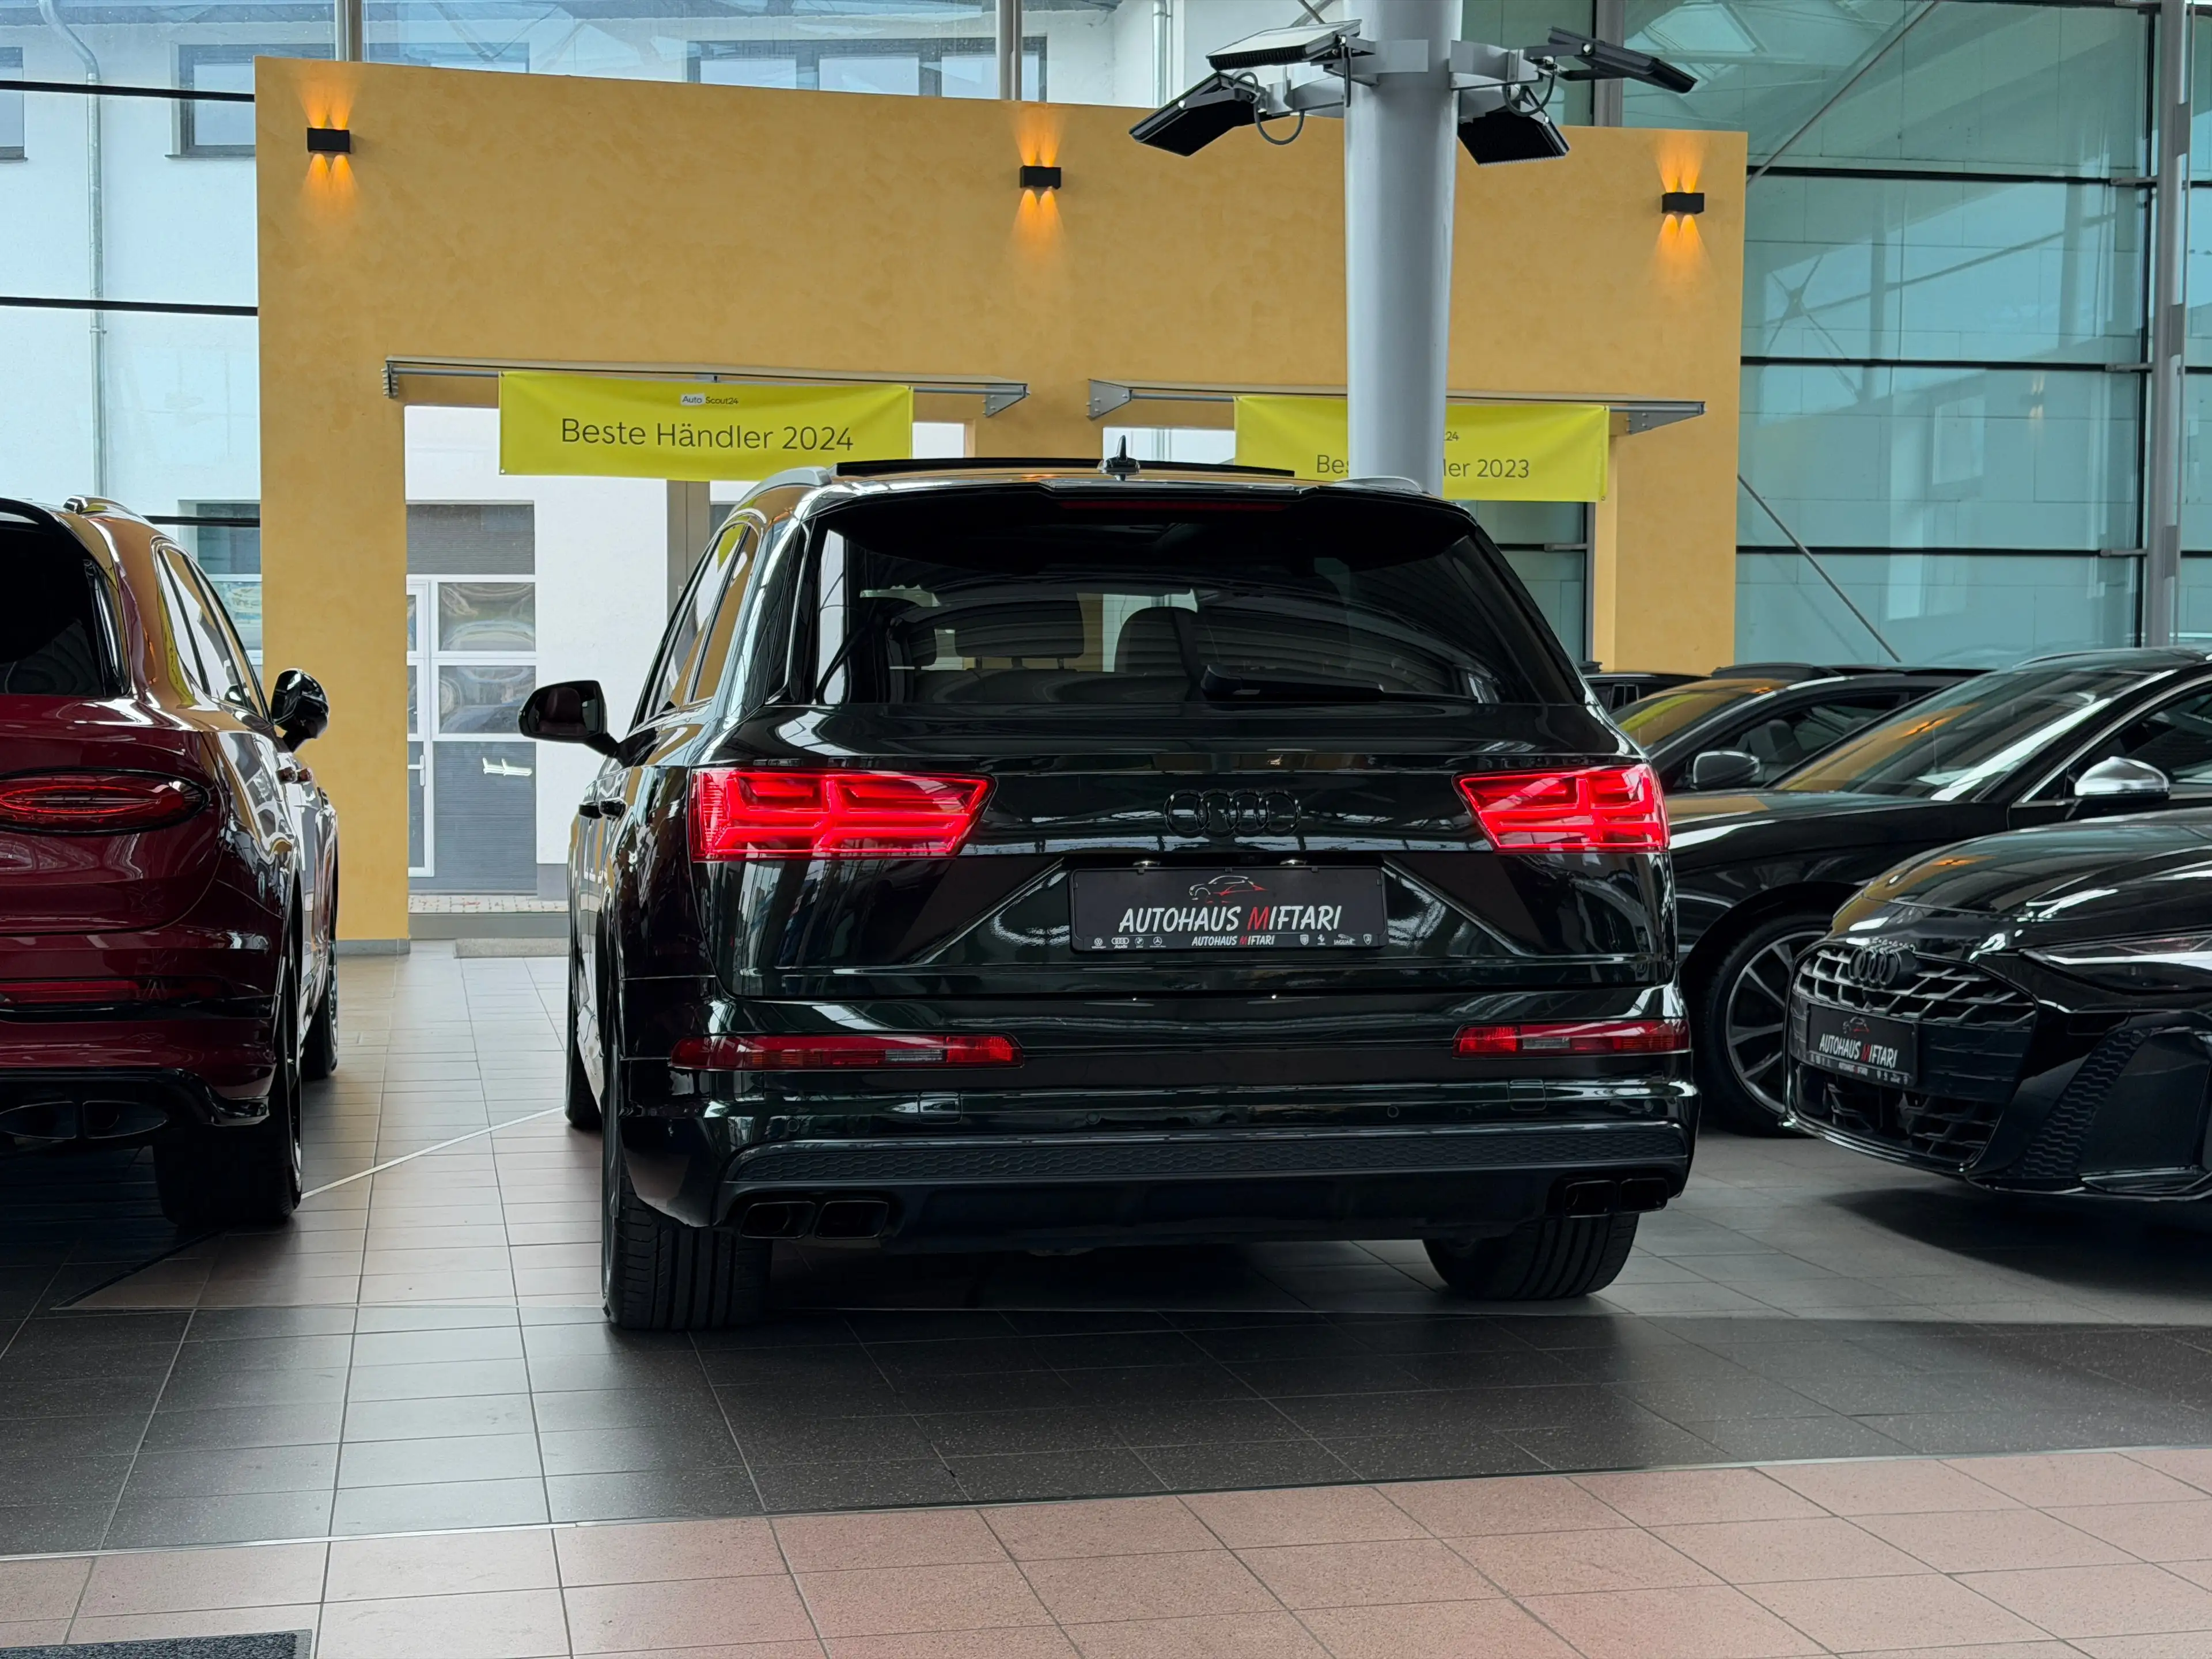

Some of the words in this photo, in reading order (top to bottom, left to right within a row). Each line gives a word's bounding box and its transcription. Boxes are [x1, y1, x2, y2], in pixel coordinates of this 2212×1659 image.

[682, 396, 703, 404] Auto
[706, 396, 738, 405] Scout24
[562, 418, 646, 445] Beste
[657, 421, 774, 449] Händler
[782, 426, 854, 451] 2024
[1477, 459, 1529, 478] 2023
[1118, 906, 1241, 933] AUTOHAUS
[1247, 906, 1342, 931] MIFTARI
[1191, 935, 1237, 946] AUTOHAUS
[1240, 935, 1275, 946] MIFTARI
[1819, 1033, 1861, 1060] AUTOHAUS
[1861, 1043, 1898, 1069] MIFTARI
